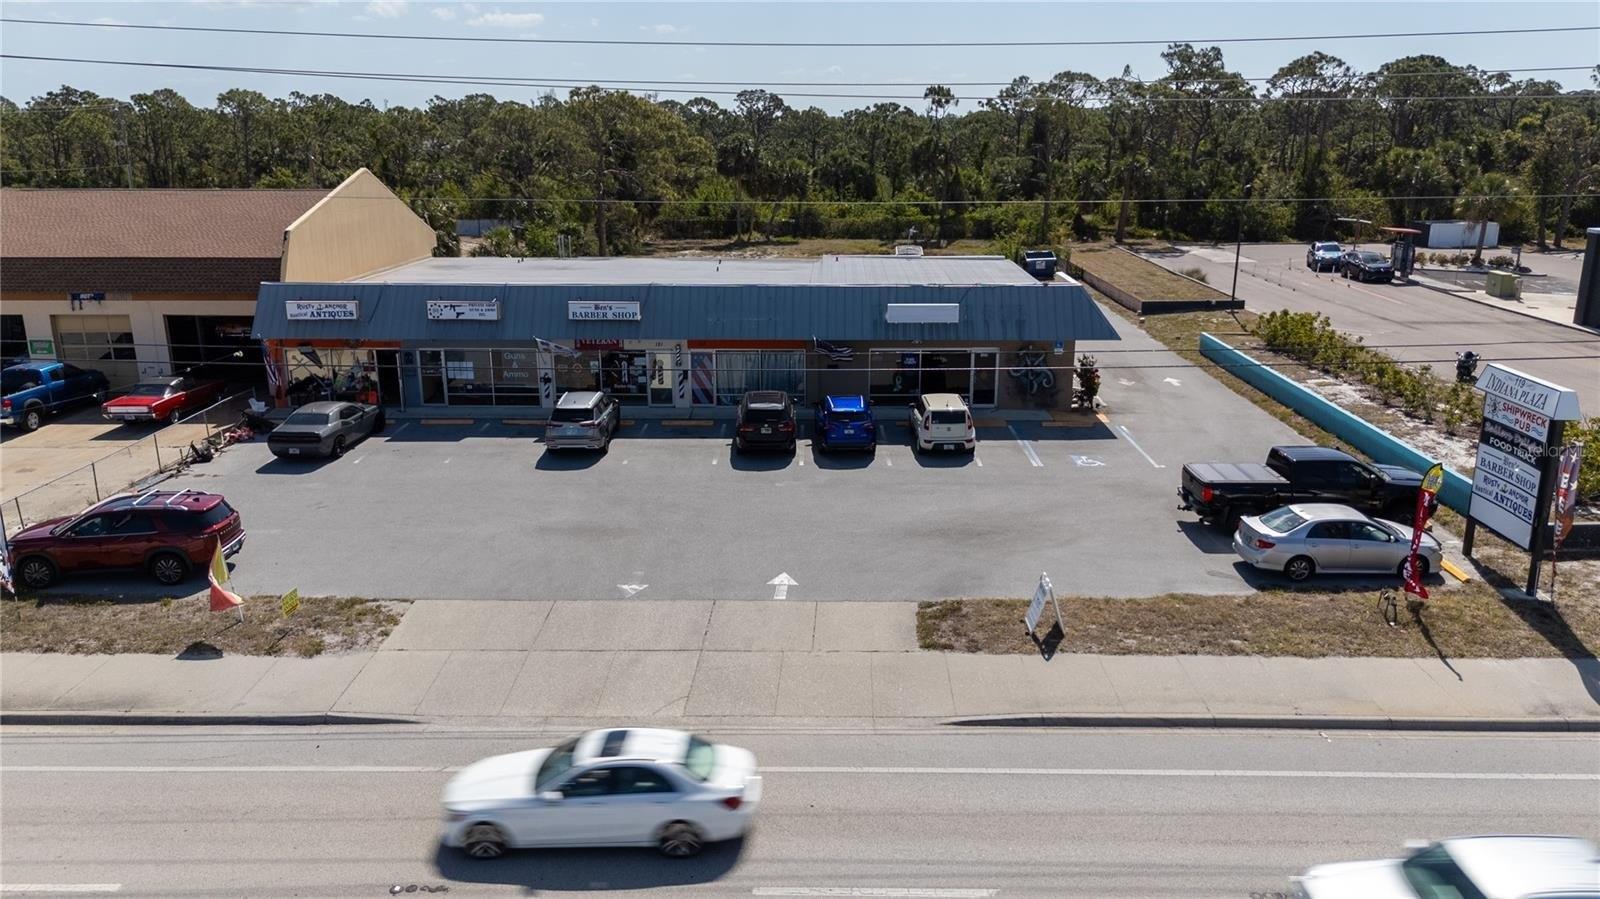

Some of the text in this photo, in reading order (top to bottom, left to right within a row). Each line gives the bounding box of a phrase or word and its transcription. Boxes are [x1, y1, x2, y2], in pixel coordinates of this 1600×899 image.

[502, 370, 528, 378] Ammo
[1514, 378, 1526, 388] 119
[1486, 373, 1548, 410] INDIANA PLAZA
[1502, 402, 1547, 428] SHIPWRECK
[1514, 418, 1531, 432] PUB
[1489, 437, 1512, 452] FOOD
[1512, 447, 1536, 465] TRUCK
[1480, 457, 1536, 492] BARBER SHOP
[1493, 492, 1532, 521] ANTIQUES
[1508, 489, 1529, 506] ANCHOR
